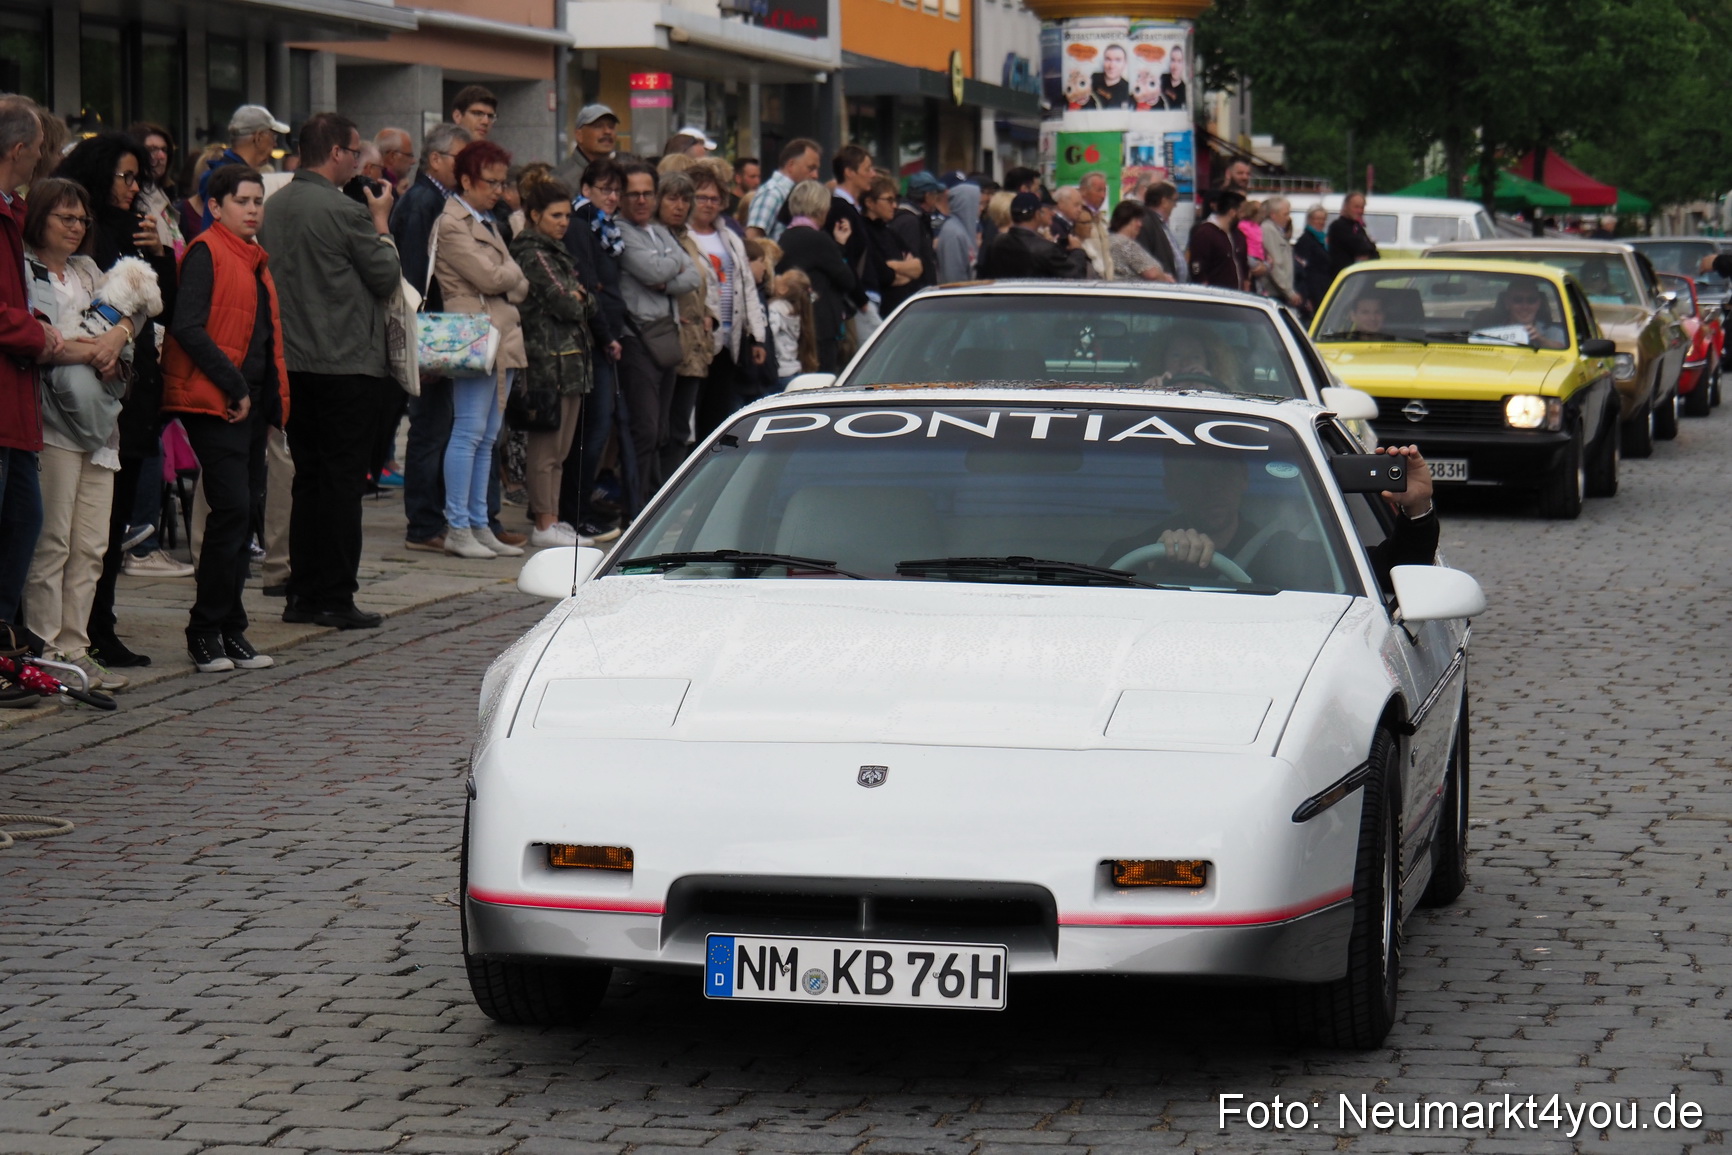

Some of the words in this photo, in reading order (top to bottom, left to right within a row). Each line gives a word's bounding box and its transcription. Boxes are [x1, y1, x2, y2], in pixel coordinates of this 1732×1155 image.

[747, 410, 1270, 451] PONTIAC
[714, 972, 725, 986] D
[736, 944, 799, 992] NM
[832, 948, 894, 996] KB
[907, 951, 1001, 999] 76H
